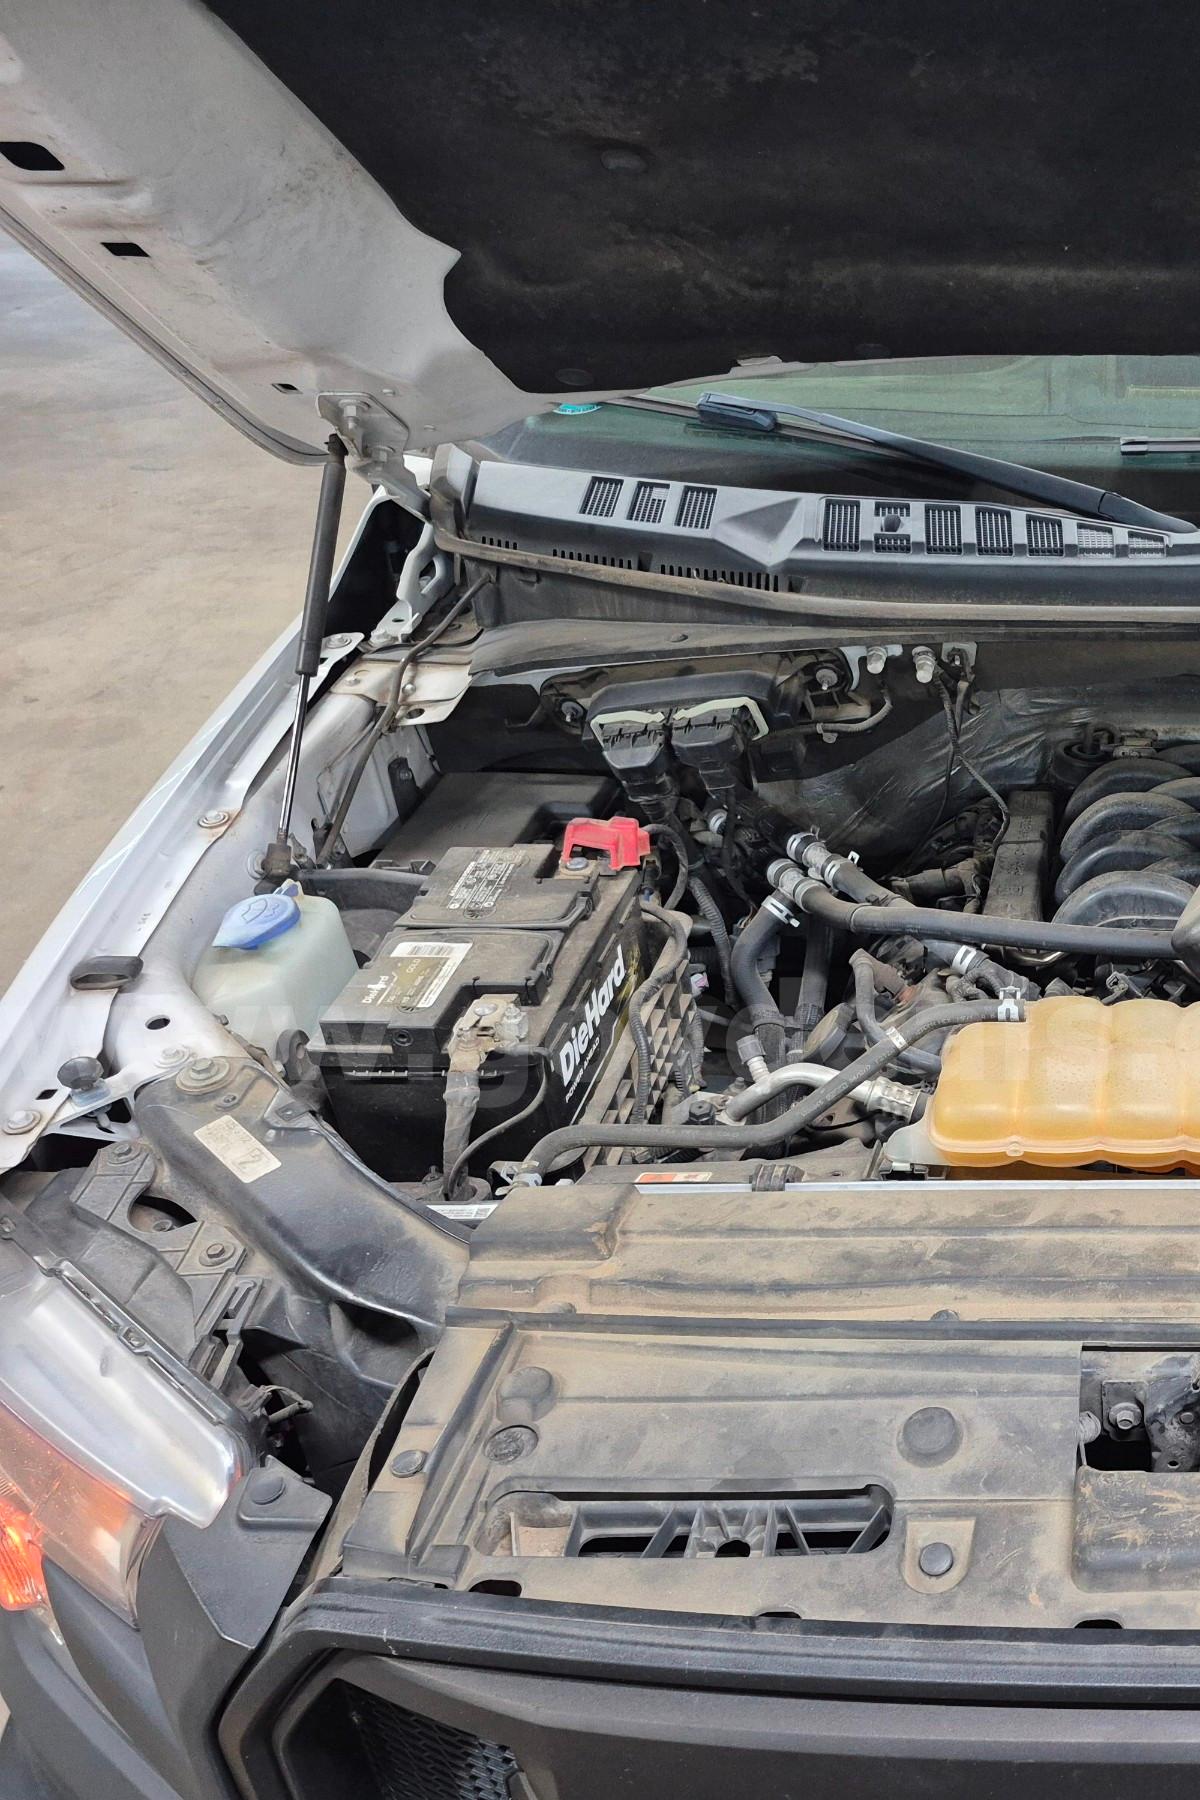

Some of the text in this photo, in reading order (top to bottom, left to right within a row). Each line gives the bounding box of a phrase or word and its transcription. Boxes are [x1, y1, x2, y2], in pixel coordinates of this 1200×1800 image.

[559, 943, 627, 1088] DieHard
[565, 1034, 601, 1104] POWER AHEAD
